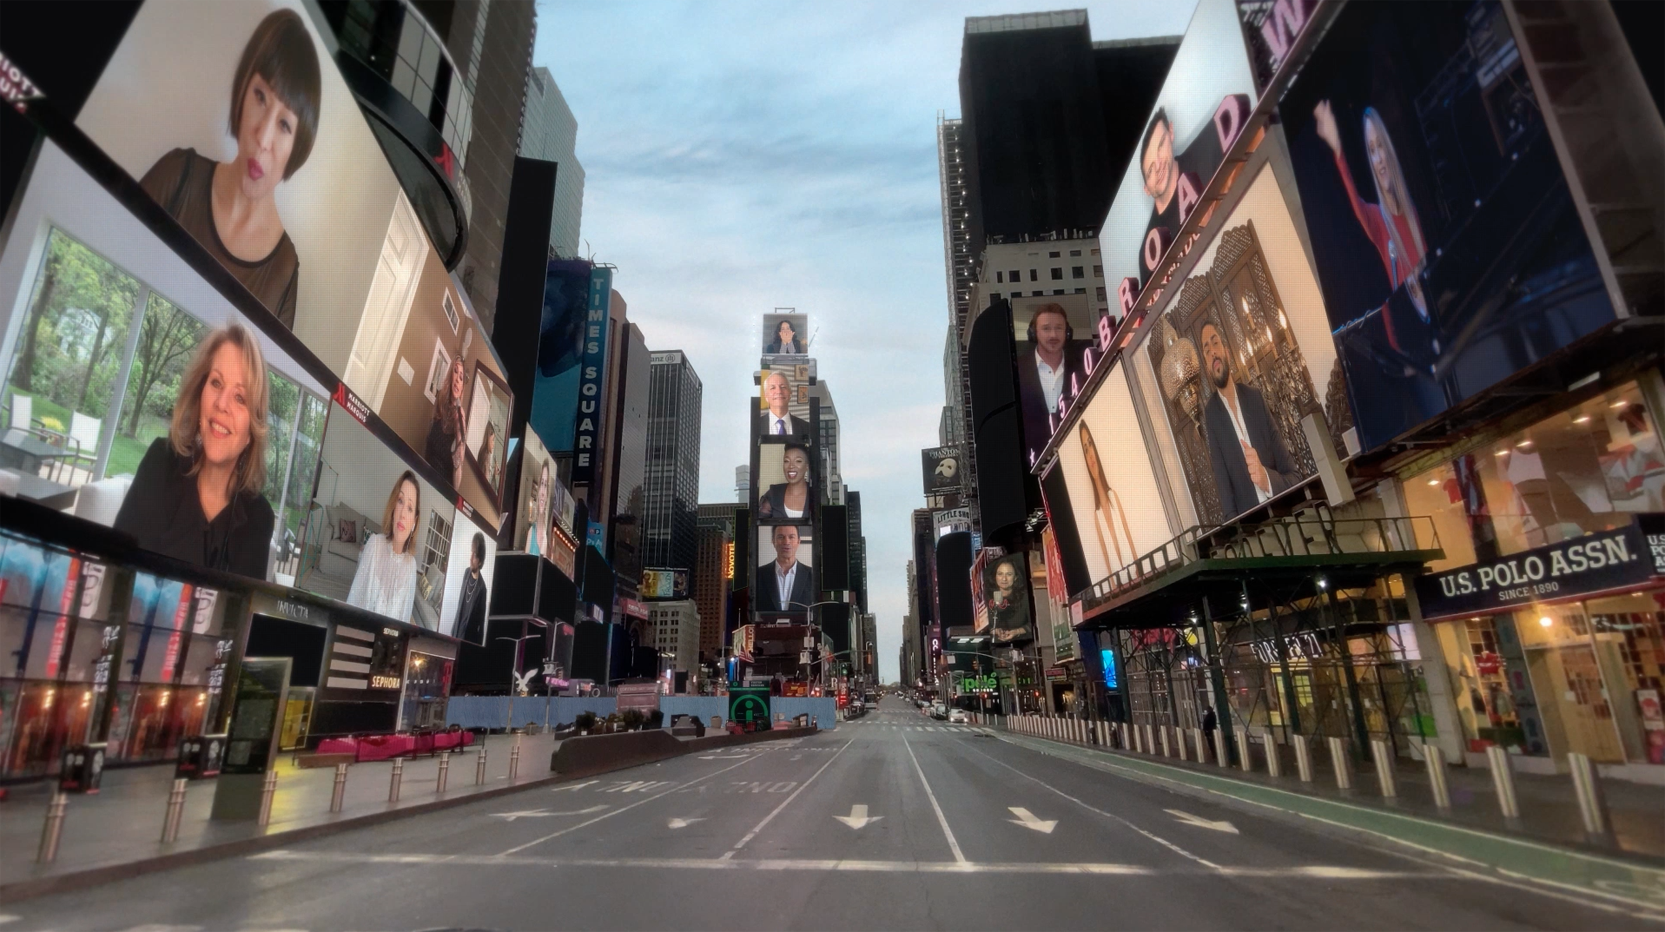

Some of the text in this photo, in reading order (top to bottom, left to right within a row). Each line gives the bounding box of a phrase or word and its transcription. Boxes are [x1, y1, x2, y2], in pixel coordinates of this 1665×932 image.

[578, 278, 604, 467] TIMES SQUARE
[346, 402, 367, 423] MARQUIS
[348, 393, 371, 416] MARRIOTT
[938, 511, 957, 523] LITTLE
[727, 541, 735, 579] NOVOTEL
[1439, 534, 1638, 597] U.S. POLO ASSN.
[1498, 581, 1559, 601] SINCE 1890
[277, 600, 309, 618] INVICTA
[1250, 633, 1324, 664] FOREER 21
[371, 675, 401, 689] SEPHORA
